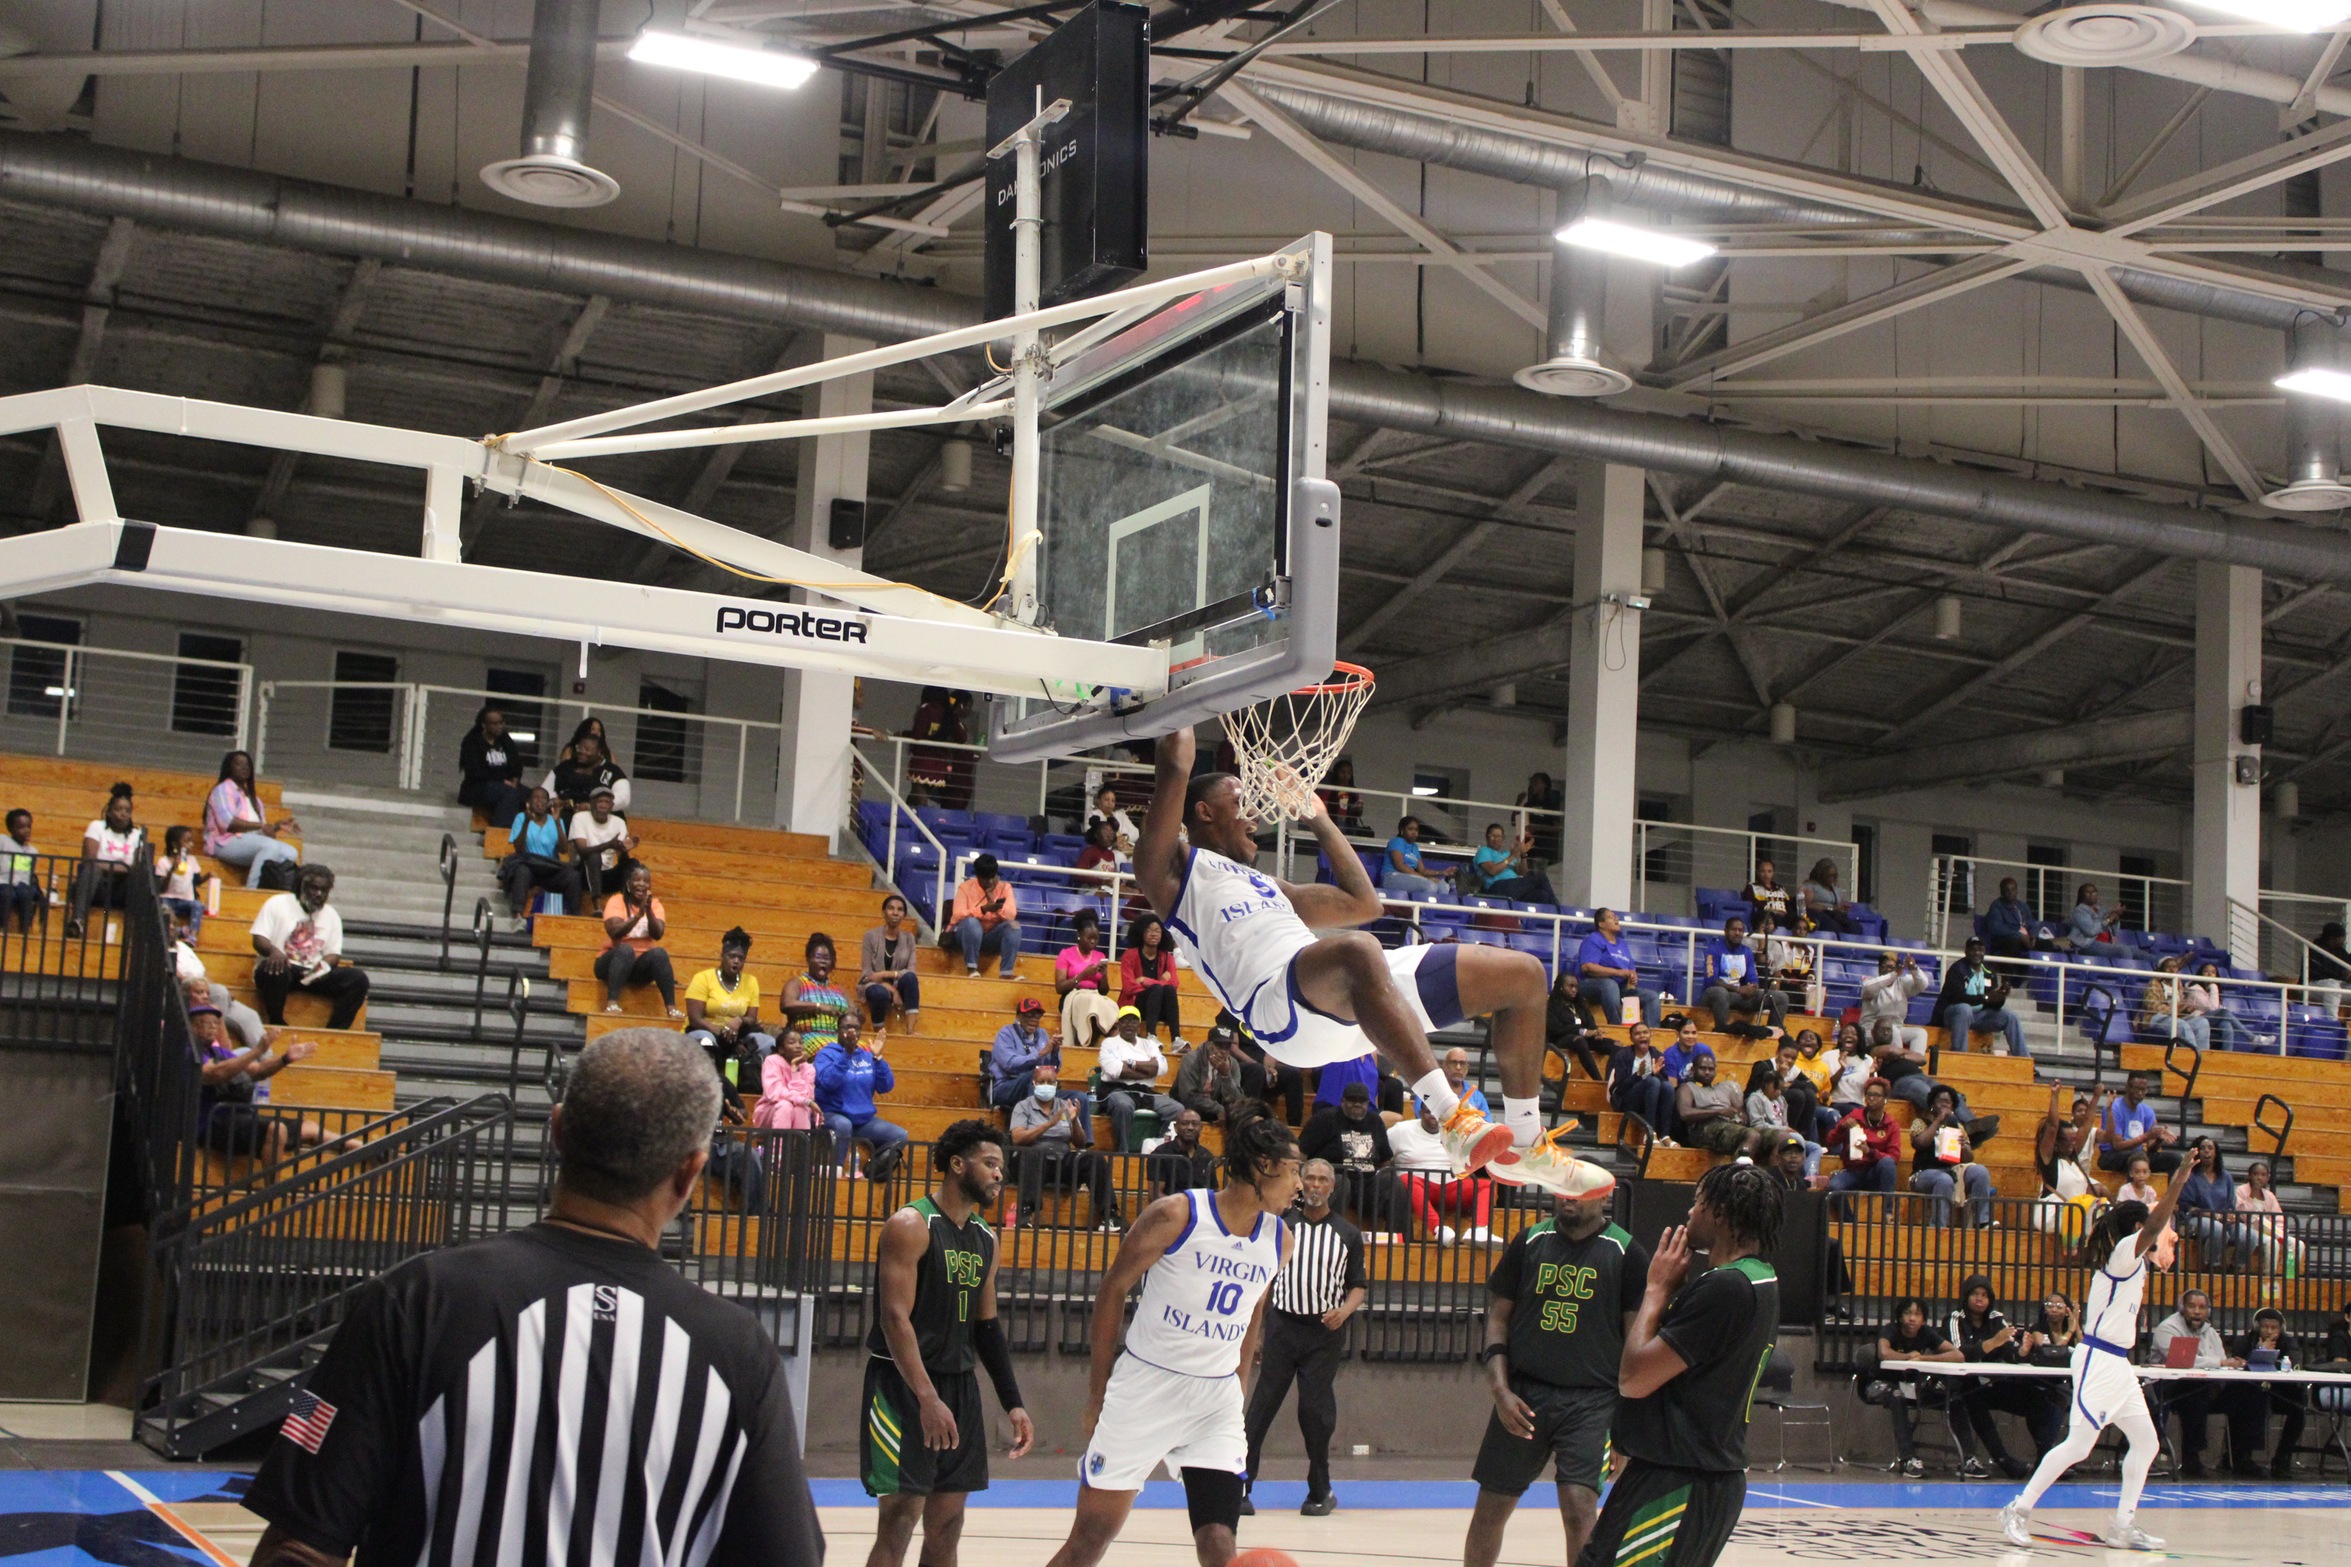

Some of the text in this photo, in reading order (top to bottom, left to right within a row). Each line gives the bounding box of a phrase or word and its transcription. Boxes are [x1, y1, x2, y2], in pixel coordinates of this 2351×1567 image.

[998, 139, 1077, 207] DAONICS
[944, 1249, 983, 1288] PSC
[1195, 1251, 1272, 1284] VIRGIN
[1535, 1262, 1598, 1300] PSC
[959, 1290, 968, 1322] 1
[1206, 1280, 1244, 1316] 10
[1540, 1300, 1579, 1334] 55
